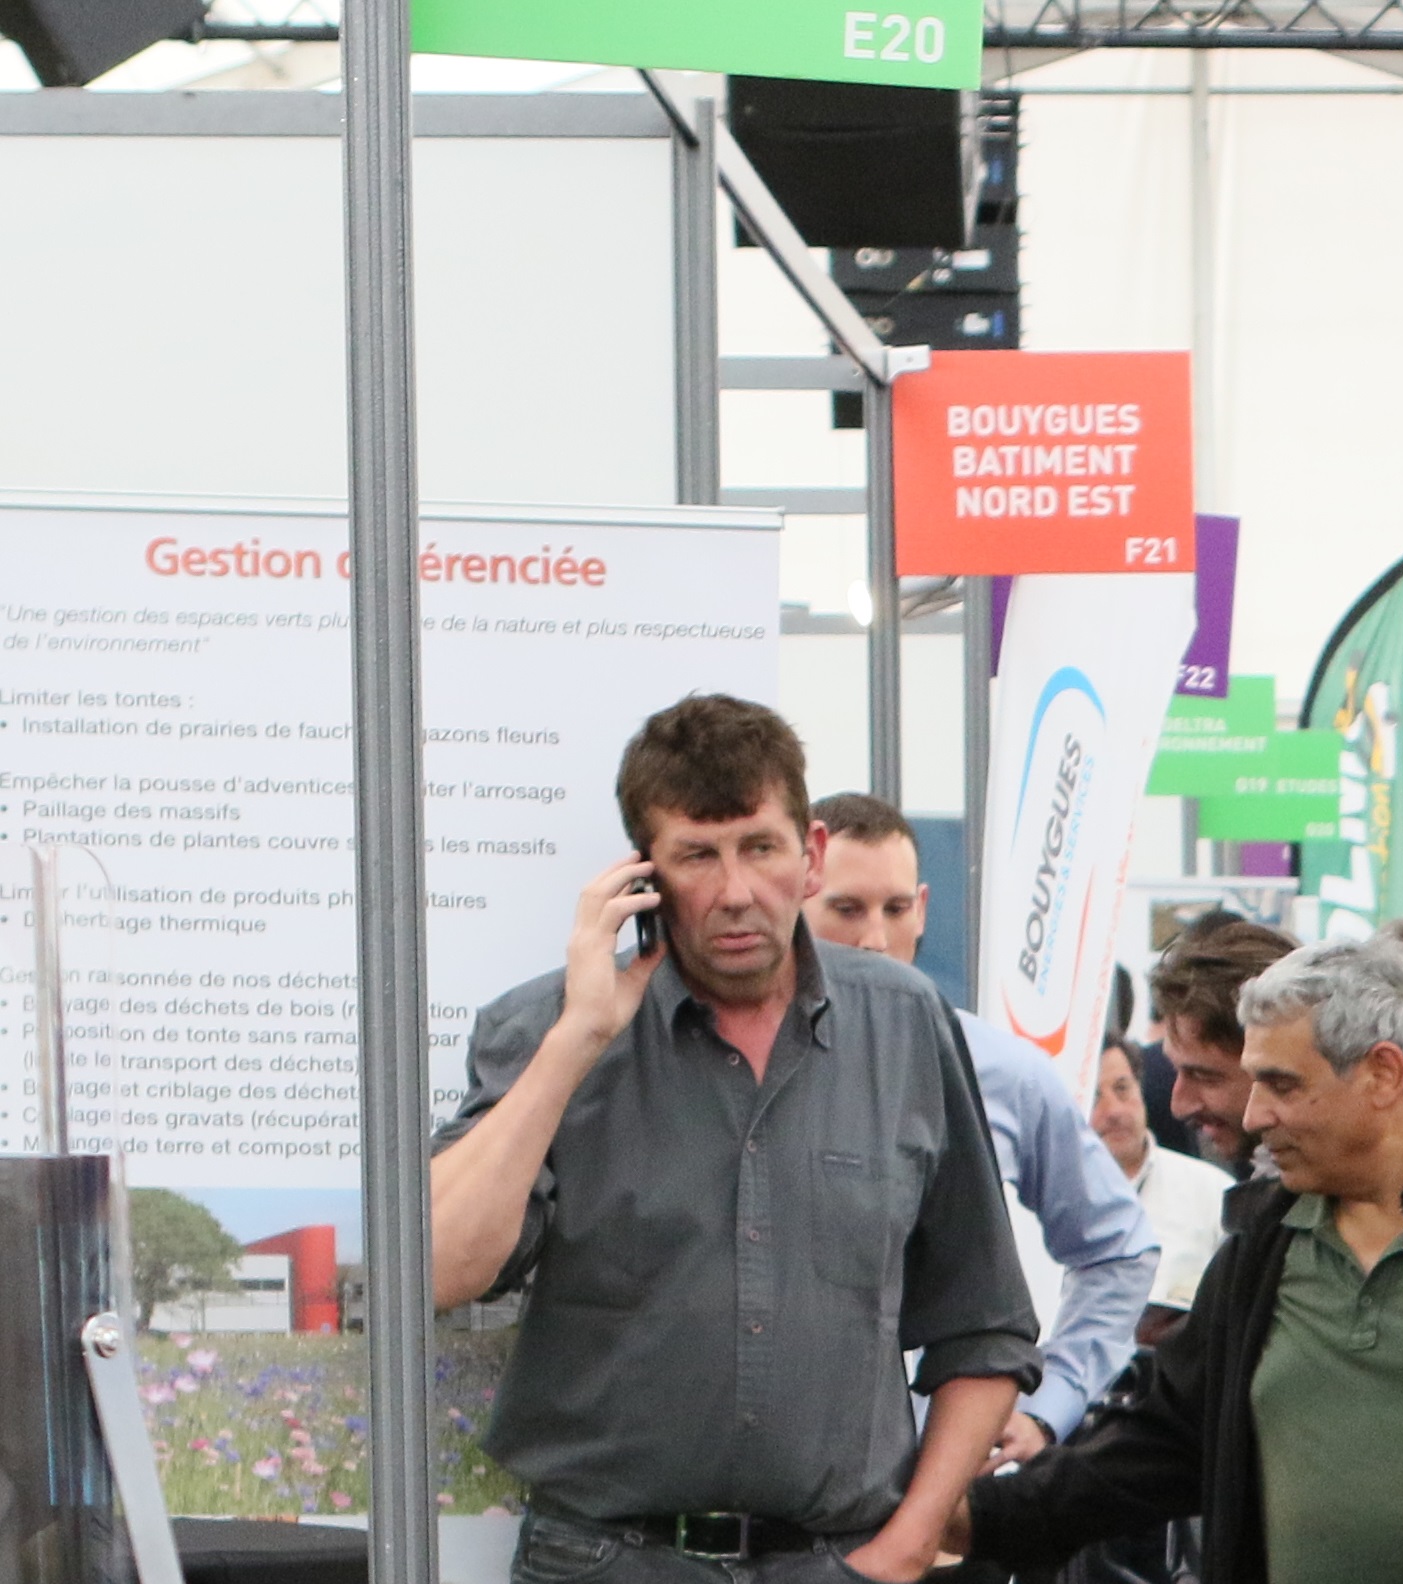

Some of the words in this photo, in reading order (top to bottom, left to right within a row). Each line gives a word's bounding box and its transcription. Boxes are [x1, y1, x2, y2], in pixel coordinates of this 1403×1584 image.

[844, 11, 945, 64] E20
[946, 403, 1140, 437] BOUYGUES
[953, 445, 1138, 477] BATIMENT
[956, 486, 1059, 518] NORD
[1068, 485, 1136, 515] EST
[144, 537, 322, 579] Gestion
[336, 543, 606, 586] érenciée
[1125, 537, 1177, 564] F21
[54, 604, 127, 634] gestion
[133, 606, 169, 625] des
[175, 610, 258, 634] espaces
[264, 611, 313, 628] verts
[317, 609, 350, 633] plu
[441, 613, 467, 632] de
[471, 613, 489, 633] la
[494, 617, 556, 634] nature
[562, 618, 582, 634] et
[585, 616, 628, 639] plus
[632, 619, 765, 641] respectueuse
[2, 633, 30, 649] de
[0, 690, 70, 707] Limiter
[77, 690, 107, 708] les
[115, 691, 181, 708] tontes
[22, 717, 138, 736] Installation
[146, 720, 172, 737] de
[179, 719, 258, 741] prairies
[264, 721, 291, 739] de
[298, 721, 353, 740] fauch
[496, 727, 560, 745] fleuris
[0, 772, 107, 793] Empêcher
[113, 774, 132, 791] la
[139, 777, 215, 798] pousse
[462, 782, 566, 803] l'arrosage
[23, 799, 106, 822] Paillage
[114, 802, 152, 820] des
[160, 803, 240, 820] massifs
[23, 828, 142, 847] Plantations
[149, 829, 175, 847] de
[183, 830, 261, 852] plantes
[267, 834, 339, 850] couvre
[441, 836, 469, 852] les
[477, 837, 556, 855] massifs
[1018, 731, 1082, 985] BOUYGUES
[200, 888, 226, 905] de
[233, 889, 320, 908] produits
[160, 916, 266, 938] thermique
[200, 970, 225, 987] de
[233, 973, 271, 988] nos
[120, 996, 152, 1014] des
[165, 996, 249, 1016] déchets
[257, 998, 283, 1016] de
[291, 998, 335, 1017] bois
[153, 1023, 179, 1041] de
[187, 1024, 241, 1042] tonte
[248, 1028, 297, 1044] sans
[95, 1052, 111, 1067] le
[121, 1054, 216, 1077] transport
[225, 1054, 261, 1072] des
[120, 1082, 139, 1097] et
[146, 1081, 232, 1102] criblage
[239, 1083, 275, 1101] des
[283, 1083, 359, 1102] déchet
[121, 1110, 157, 1127] des
[165, 1111, 243, 1131] gravats
[123, 1138, 147, 1154] de
[156, 1138, 205, 1154] terre
[212, 1138, 232, 1155] et
[239, 1140, 332, 1159] compost
